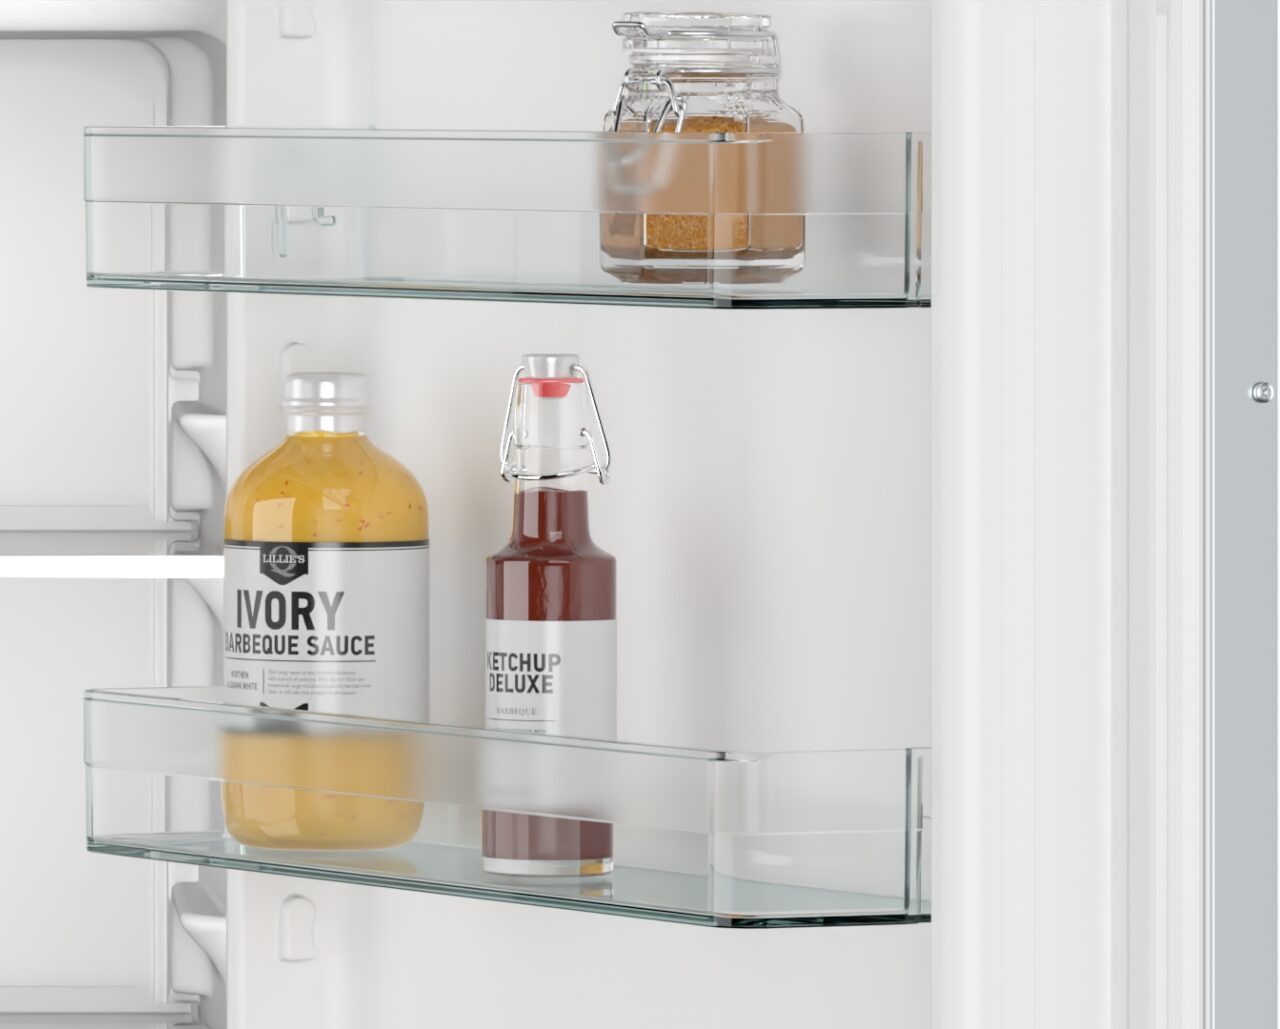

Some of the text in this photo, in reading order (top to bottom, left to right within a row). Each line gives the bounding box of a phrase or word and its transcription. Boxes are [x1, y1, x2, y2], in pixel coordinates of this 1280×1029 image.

[262, 553, 306, 564] LILLIE'S
[236, 589, 345, 631] IVORY
[224, 632, 376, 656] BARBEQUE SAUCE
[486, 651, 561, 673] KETCHUP
[489, 673, 554, 694] DELUXE
